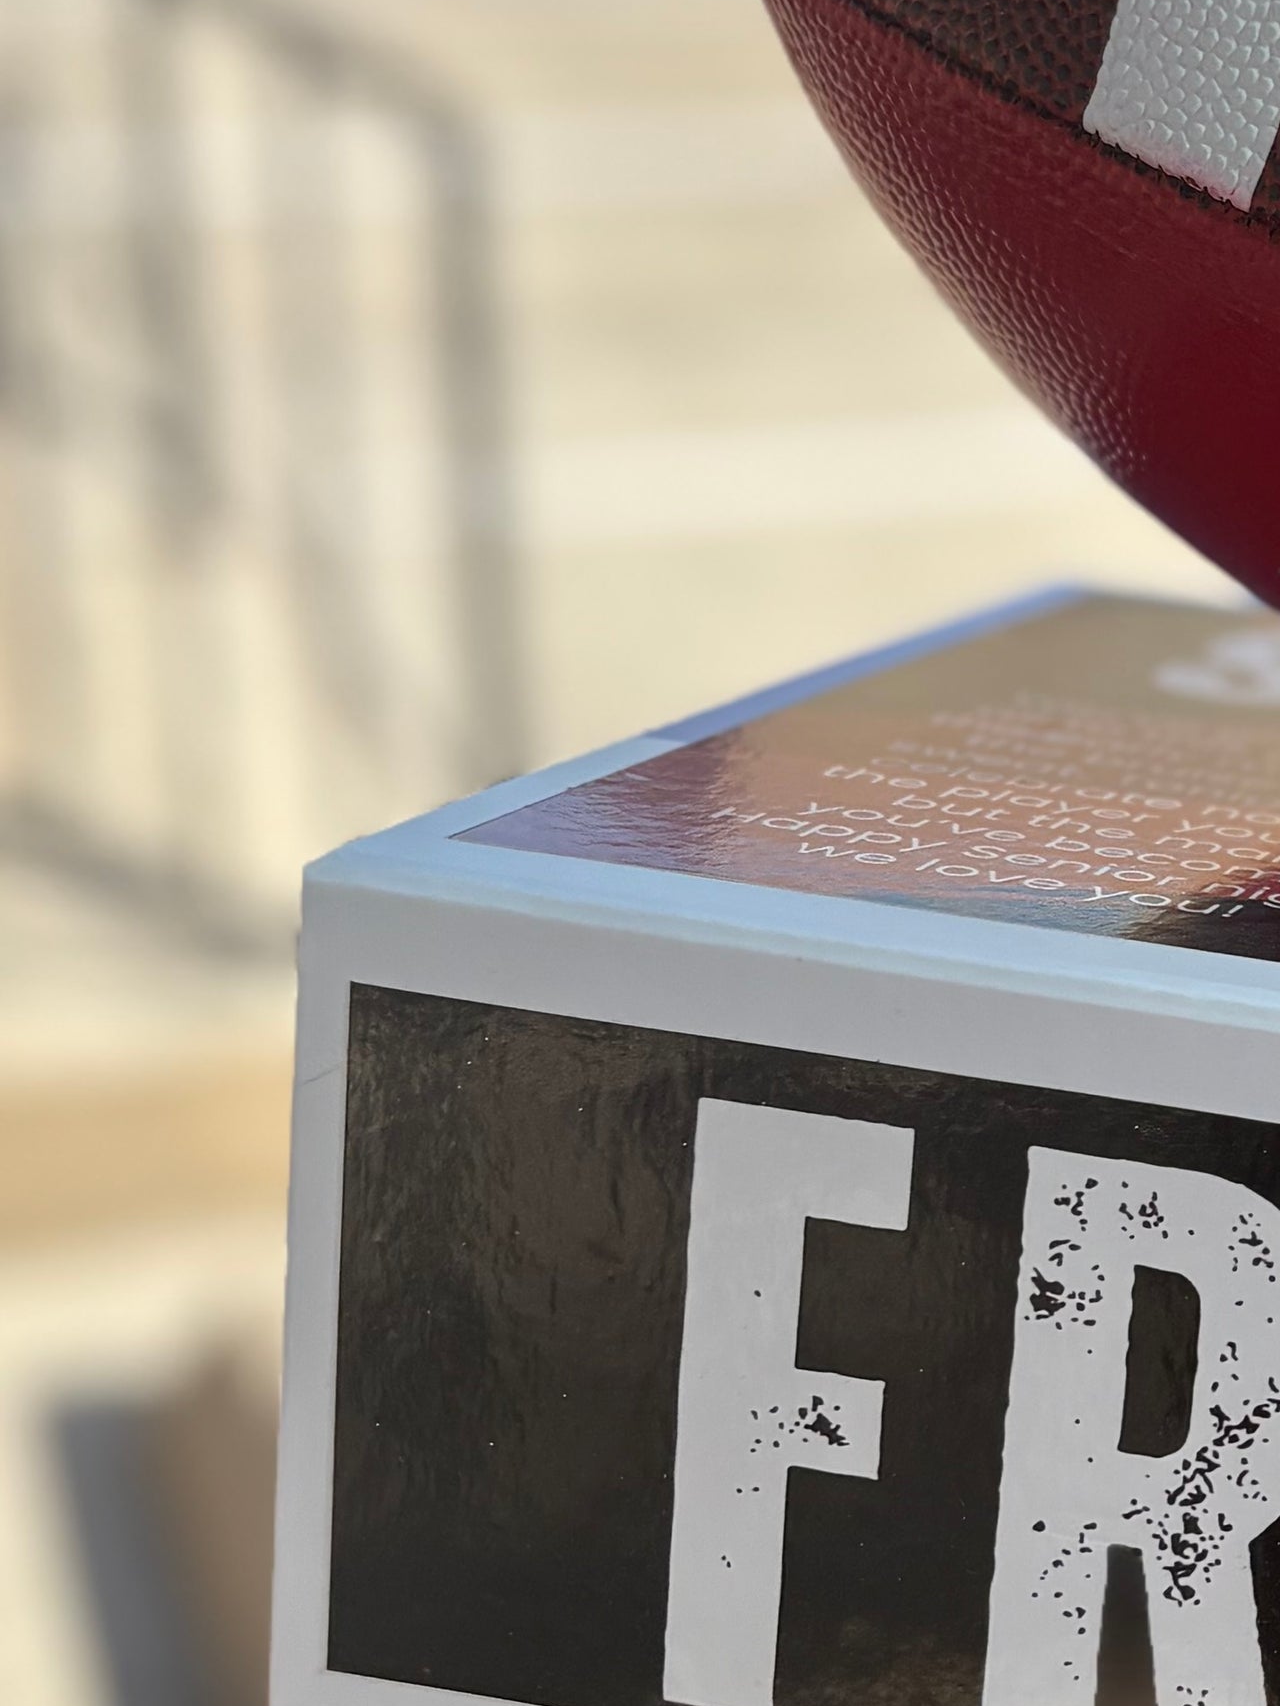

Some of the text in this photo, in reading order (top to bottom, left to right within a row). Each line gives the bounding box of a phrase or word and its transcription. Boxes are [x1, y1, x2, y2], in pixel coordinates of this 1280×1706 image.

[822, 764, 929, 789] the
[937, 784, 1161, 824] player
[891, 793, 1012, 821] but
[1027, 812, 1136, 840] the
[710, 806, 948, 853] Happy
[796, 841, 1246, 919] we love you!
